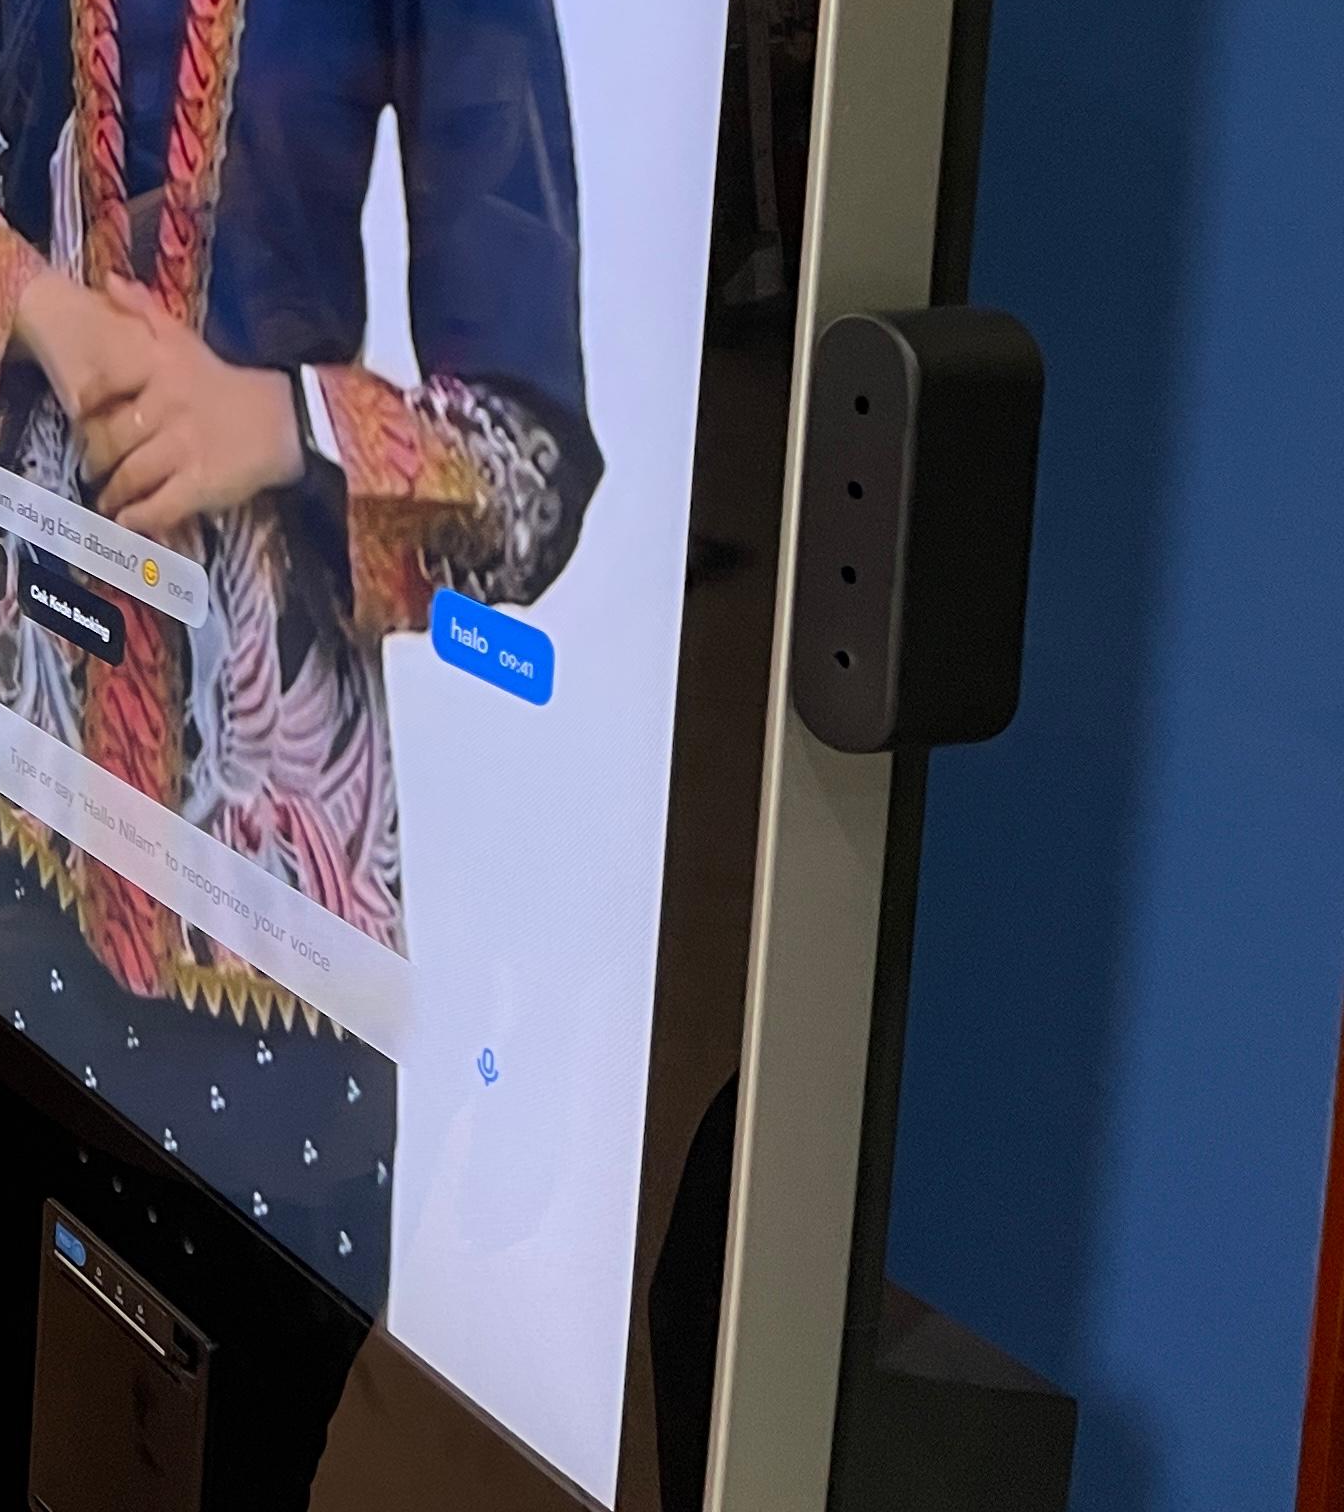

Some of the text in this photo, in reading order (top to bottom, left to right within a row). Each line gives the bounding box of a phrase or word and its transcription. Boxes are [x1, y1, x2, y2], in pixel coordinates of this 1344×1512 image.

[16, 502, 39, 524] ada
[40, 516, 55, 534] yg
[57, 517, 82, 545] bisa
[83, 533, 139, 574] dibantu?
[450, 616, 534, 680] halo 09:41
[9, 746, 37, 779] Type
[39, 767, 53, 786] or
[54, 777, 76, 807] say
[165, 851, 179, 873] to
[182, 864, 250, 918] recognize
[252, 901, 287, 942] your
[290, 934, 332, 973] voice
